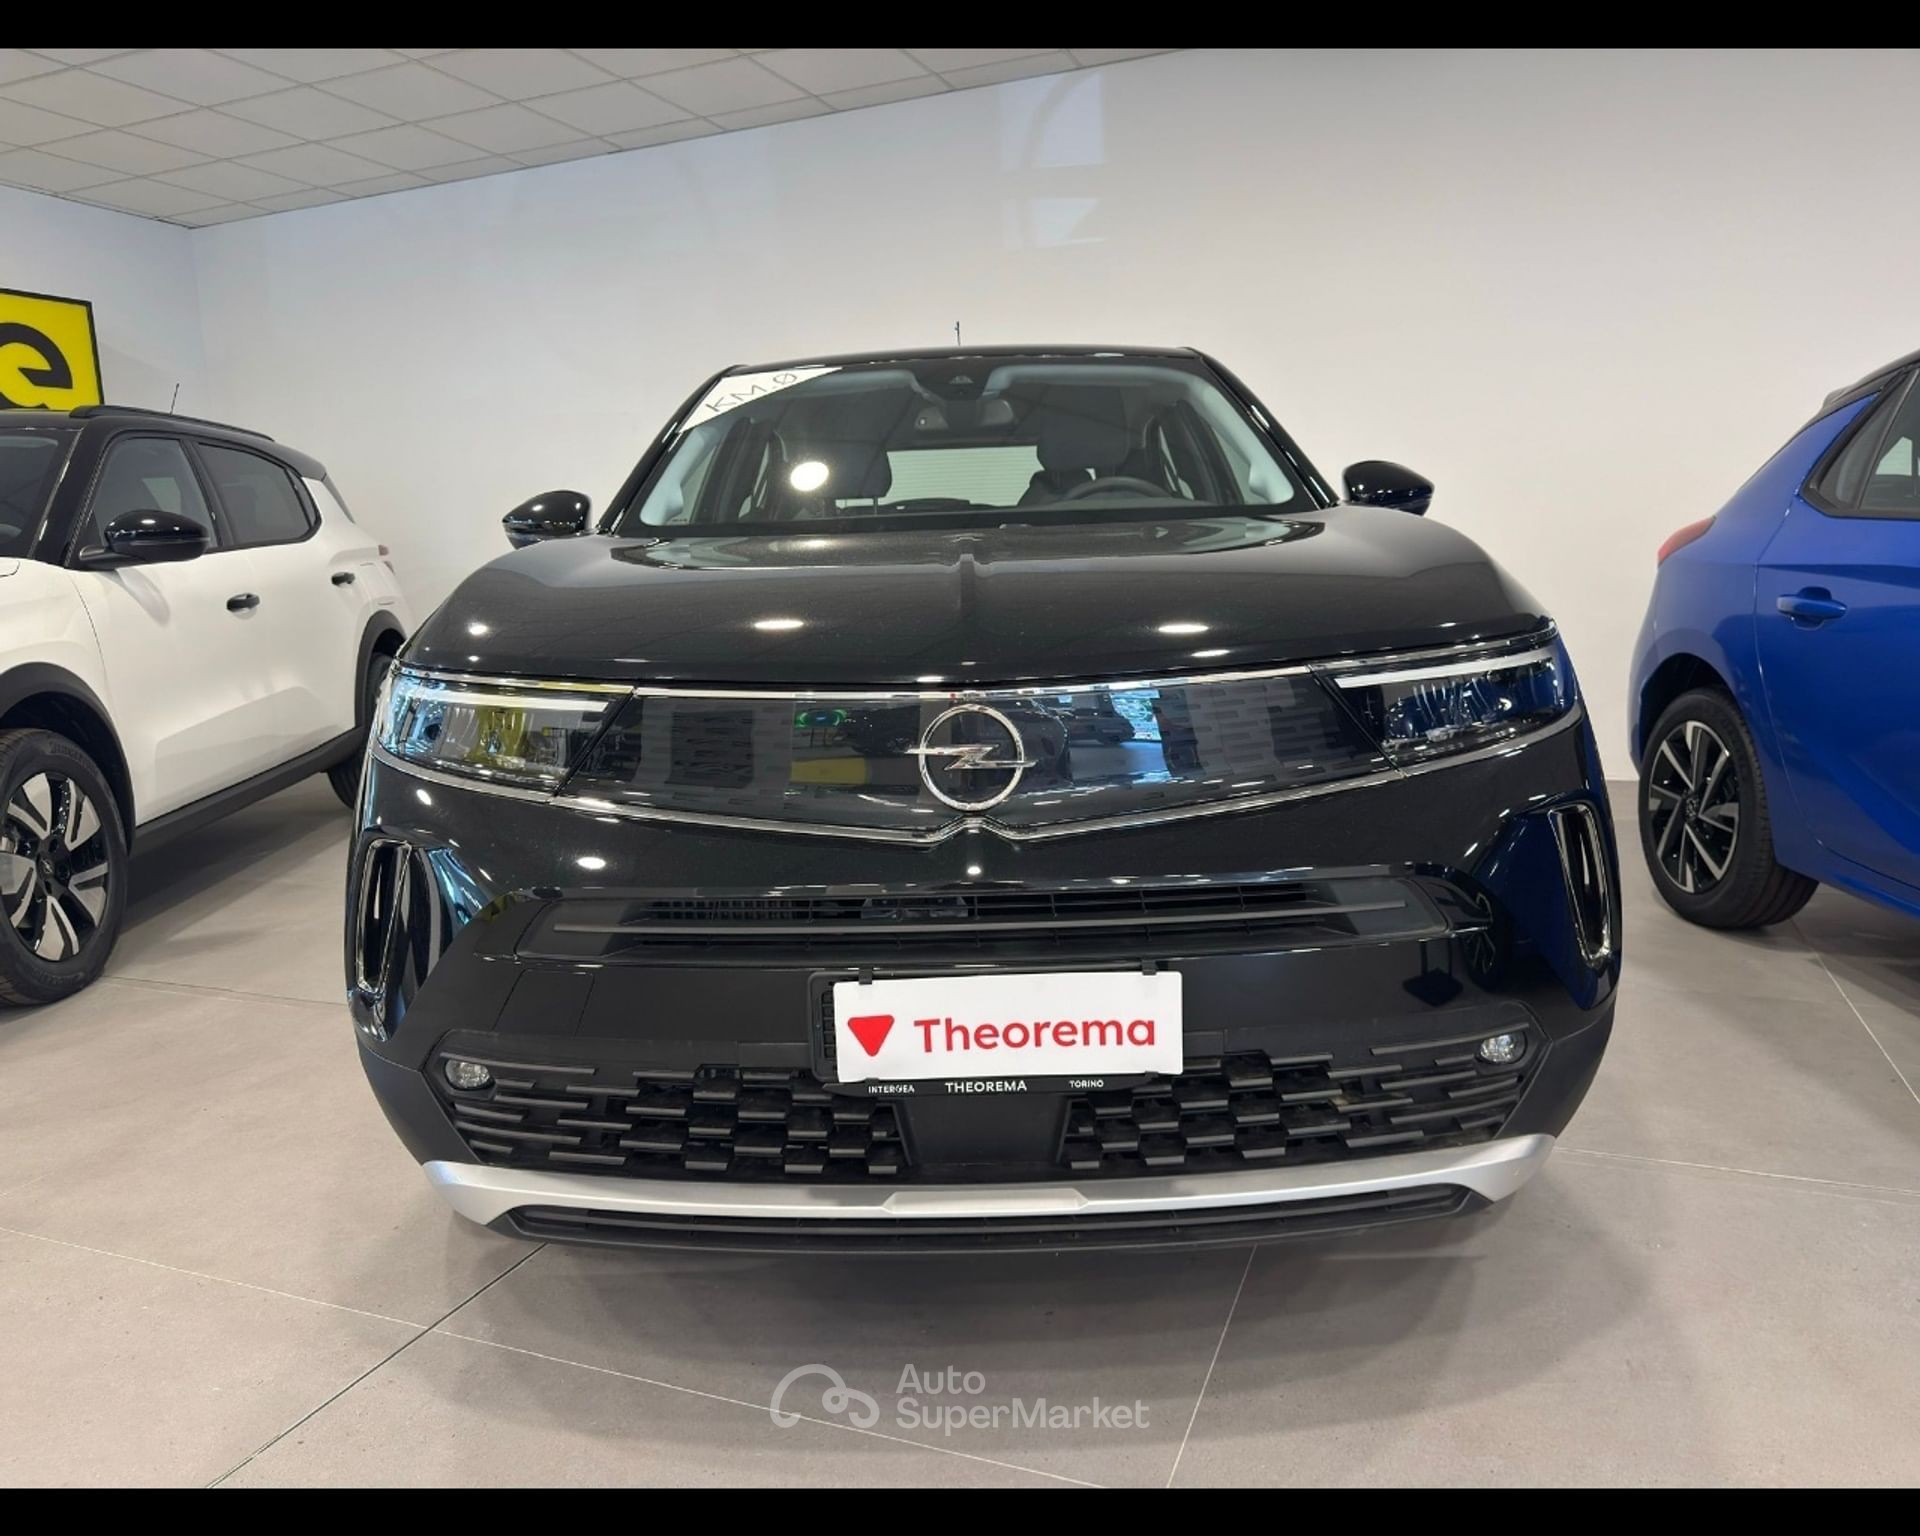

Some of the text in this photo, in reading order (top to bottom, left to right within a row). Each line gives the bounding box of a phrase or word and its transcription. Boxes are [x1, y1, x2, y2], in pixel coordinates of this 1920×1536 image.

[913, 1017, 1156, 1053] Theorema
[944, 1079, 1028, 1094] THEOREMA
[1068, 1079, 1105, 1089] TORINO
